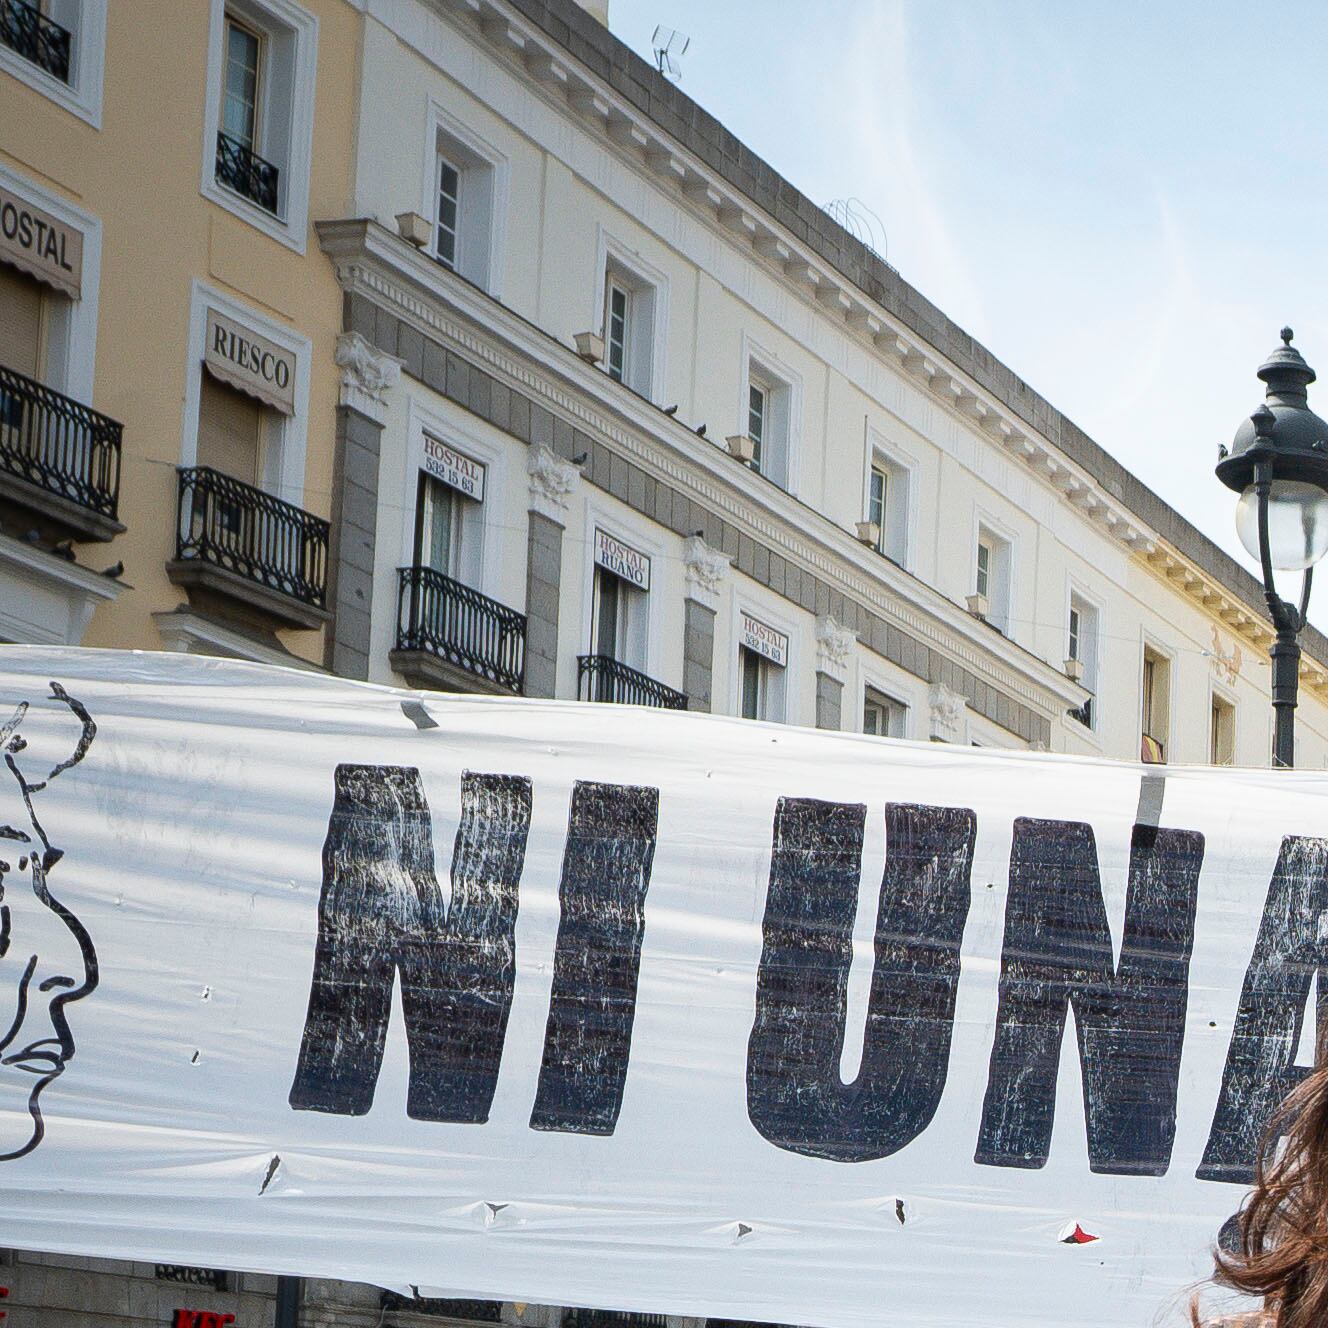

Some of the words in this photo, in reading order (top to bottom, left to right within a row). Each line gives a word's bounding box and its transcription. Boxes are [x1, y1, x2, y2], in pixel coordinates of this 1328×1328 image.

[1, 199, 73, 272] OSTAL
[213, 323, 290, 390] RIESCO
[424, 438, 479, 482] HOSTAL
[426, 457, 445, 478] 532
[448, 469, 459, 486] 15
[600, 534, 646, 572] HOSTAL
[602, 550, 643, 584] RUANO
[744, 617, 785, 651] HOSTAL
[289, 763, 660, 1137] NI
